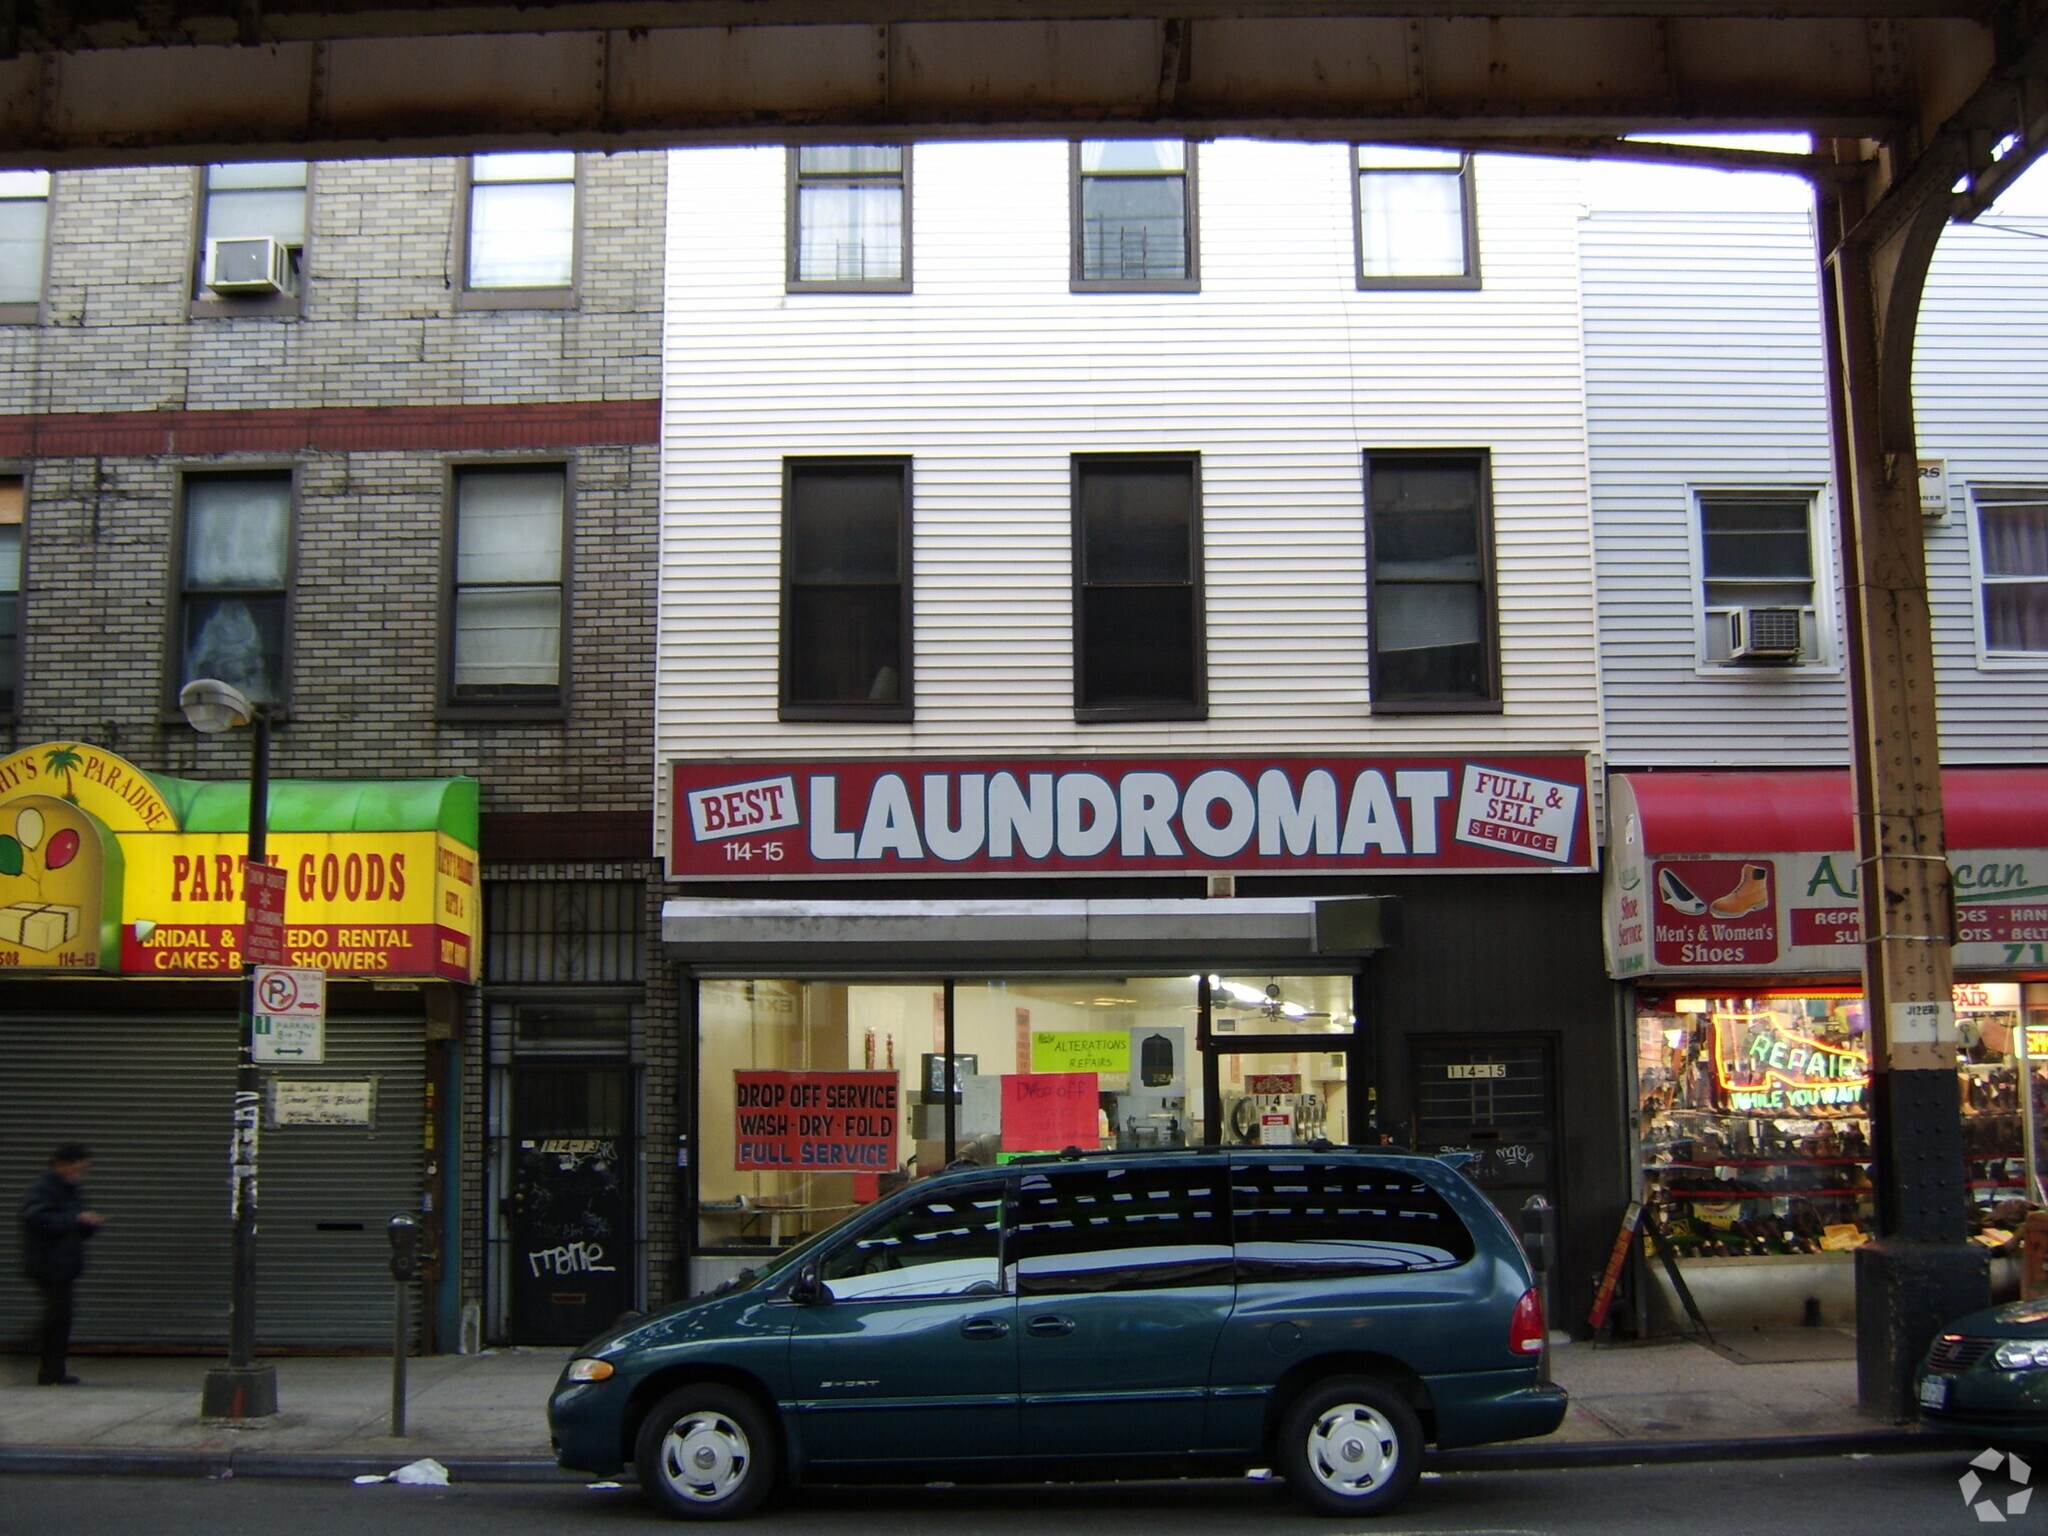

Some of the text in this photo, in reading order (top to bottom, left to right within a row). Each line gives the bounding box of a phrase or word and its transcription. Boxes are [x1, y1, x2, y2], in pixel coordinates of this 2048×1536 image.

[83, 755, 168, 831] PARADISE
[1475, 772, 1563, 809] FULL &
[700, 785, 784, 832] BEST
[809, 769, 1450, 861] LAUNDROMAT
[1486, 798, 1544, 827] SELF
[1471, 822, 1555, 851] SERVICE
[723, 841, 784, 861] 114-15
[298, 853, 406, 902] GOODS
[1815, 911, 1859, 924] REPA
[1955, 910, 1987, 922] OES
[221, 928, 236, 948] &
[338, 929, 413, 948] RENTAL
[1656, 923, 1774, 942] Men's & Women's
[1958, 928, 1992, 941] OTS
[291, 951, 388, 970] SHOWERS
[1681, 943, 1745, 963] Shoes
[1054, 1039, 1128, 1052] ALTERATIONS
[1750, 1034, 1858, 1079] REPAIR
[1069, 1058, 1113, 1068] REPAIRS
[1449, 1065, 1505, 1078] 114-15
[737, 1083, 897, 1109] DROP OFF SERVICE
[1731, 1085, 1864, 1110] WHILE YOU WAIT
[740, 1114, 892, 1137] WASH DRY FOLD
[740, 1141, 890, 1165] FULL SERVICE
